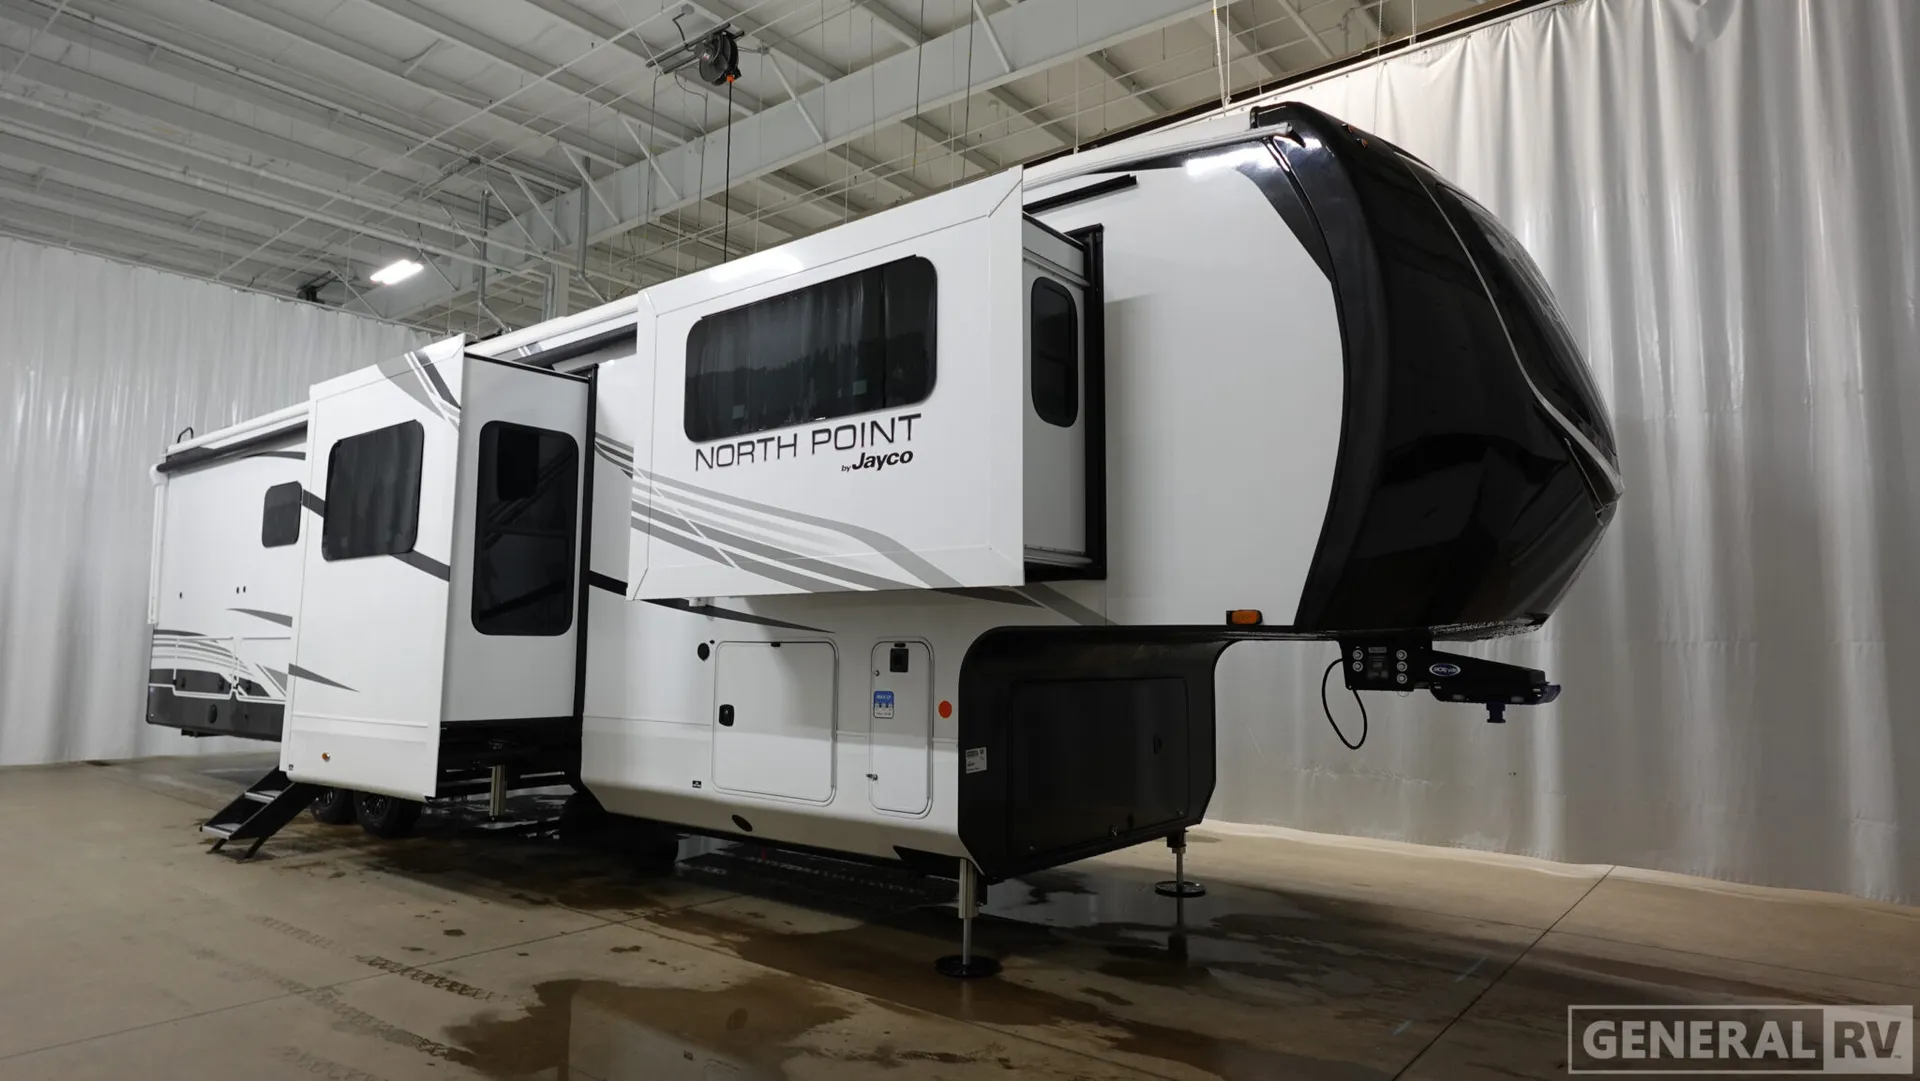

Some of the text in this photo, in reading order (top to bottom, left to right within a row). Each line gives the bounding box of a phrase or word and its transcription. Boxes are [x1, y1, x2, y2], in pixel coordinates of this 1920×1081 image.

[695, 413, 922, 472] NORTH POINT
[841, 450, 914, 473] by Jayco
